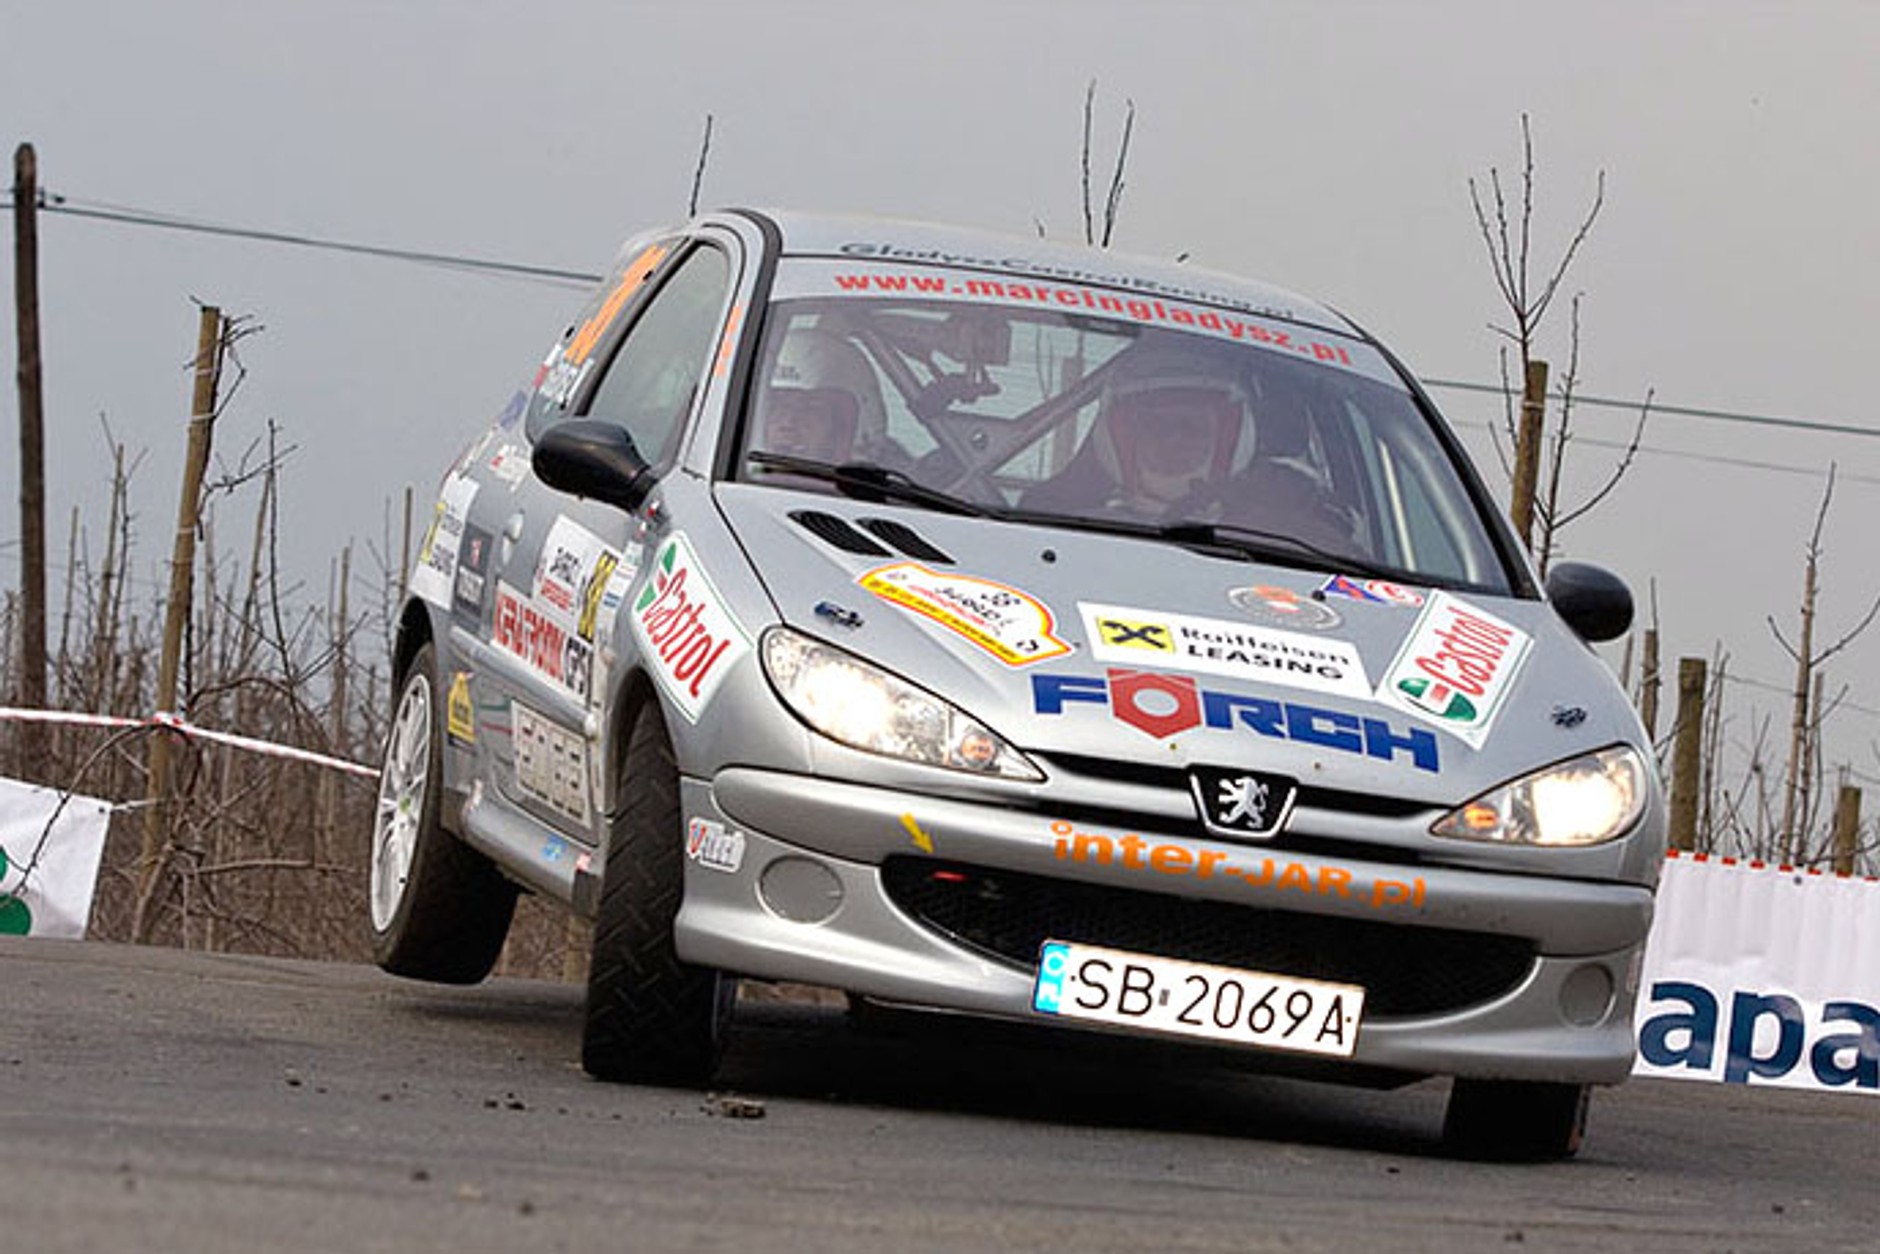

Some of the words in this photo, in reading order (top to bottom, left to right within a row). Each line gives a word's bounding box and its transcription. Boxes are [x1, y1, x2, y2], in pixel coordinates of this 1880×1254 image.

[835, 275, 1353, 366] www.marcingladysz.pl
[642, 568, 730, 698] Castrol
[1187, 644, 1344, 680] LEASING
[1415, 606, 1513, 696] Castrol
[1050, 820, 1427, 909] inter-JAR.pl
[1074, 958, 1156, 1018] SB
[1177, 973, 1346, 1046] 2069A
